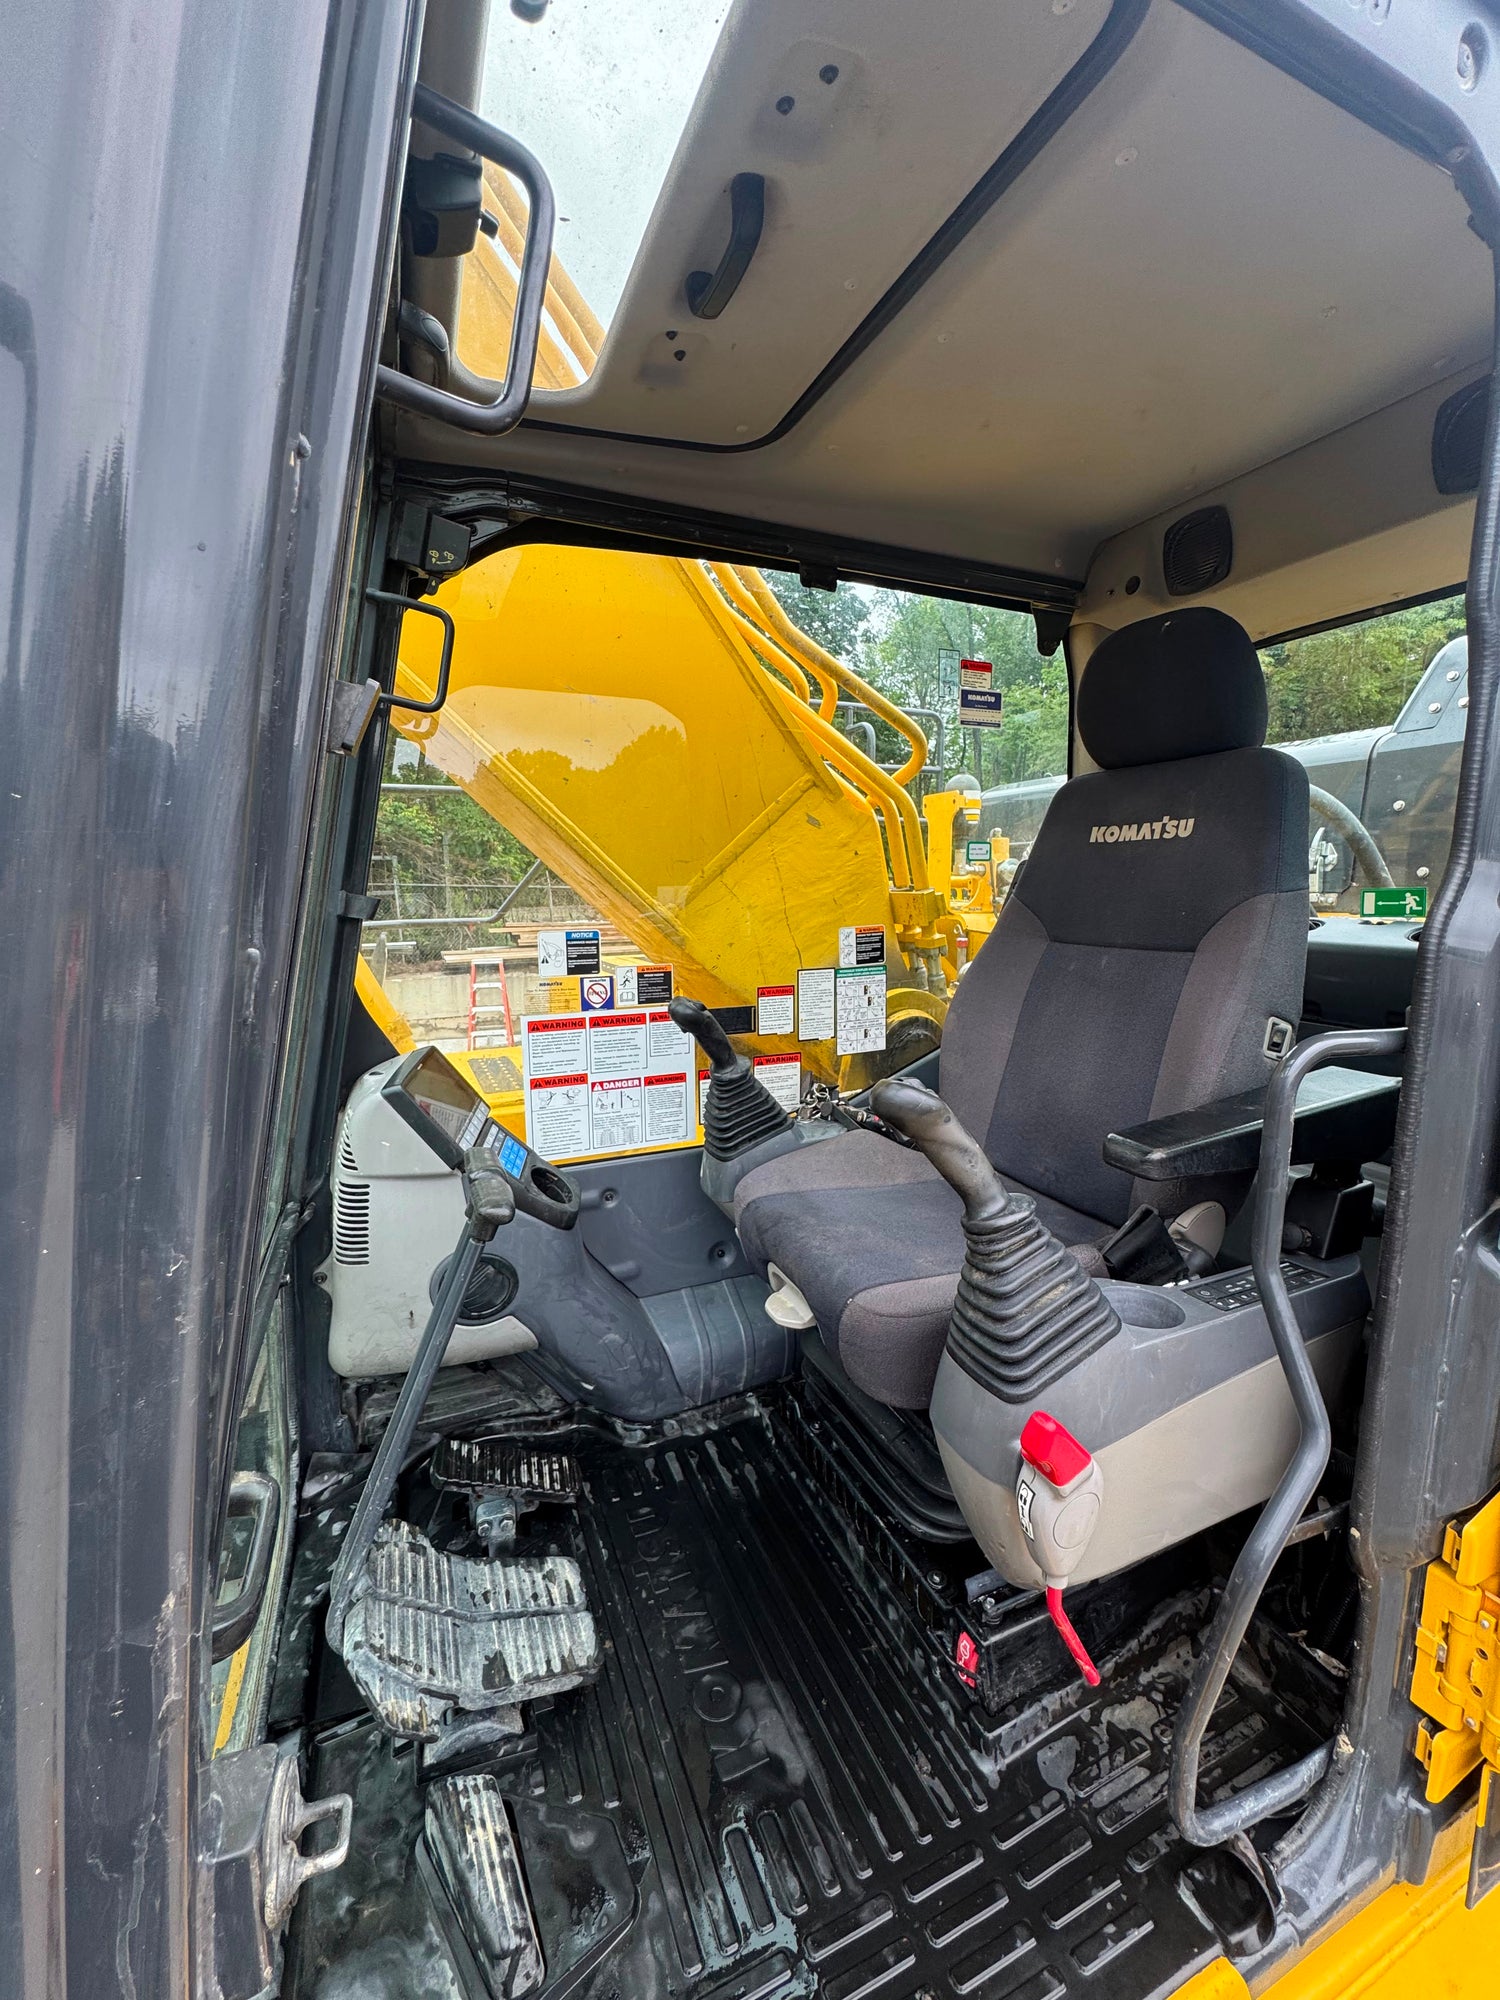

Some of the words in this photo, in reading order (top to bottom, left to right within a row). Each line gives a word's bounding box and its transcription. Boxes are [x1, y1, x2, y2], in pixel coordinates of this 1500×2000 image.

[968, 694, 995, 703] KOMATSU
[1089, 816, 1195, 843] KOMATSU
[542, 1020, 583, 1030] WARNING
[603, 1016, 642, 1025] WARNING
[765, 1055, 799, 1064] WARNING
[544, 1076, 585, 1086] WARNING
[603, 1079, 640, 1089] DANGER
